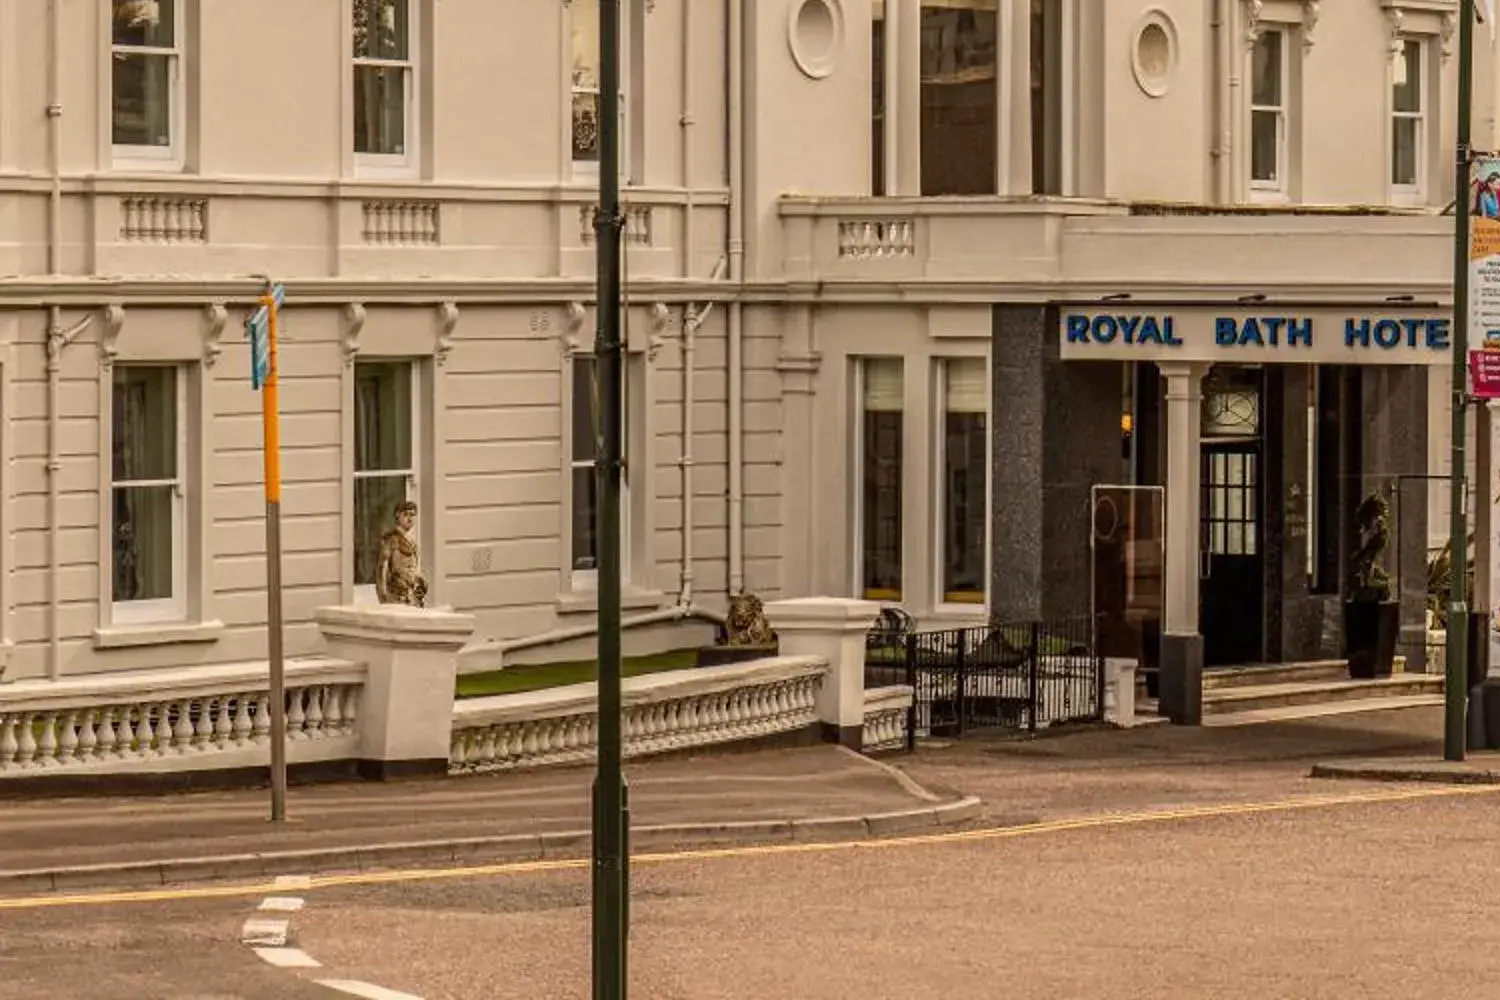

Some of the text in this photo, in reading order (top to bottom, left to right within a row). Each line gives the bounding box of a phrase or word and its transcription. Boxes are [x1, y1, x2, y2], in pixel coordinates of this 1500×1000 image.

[1065, 314, 1451, 348] ROYAL BATH HOTE
